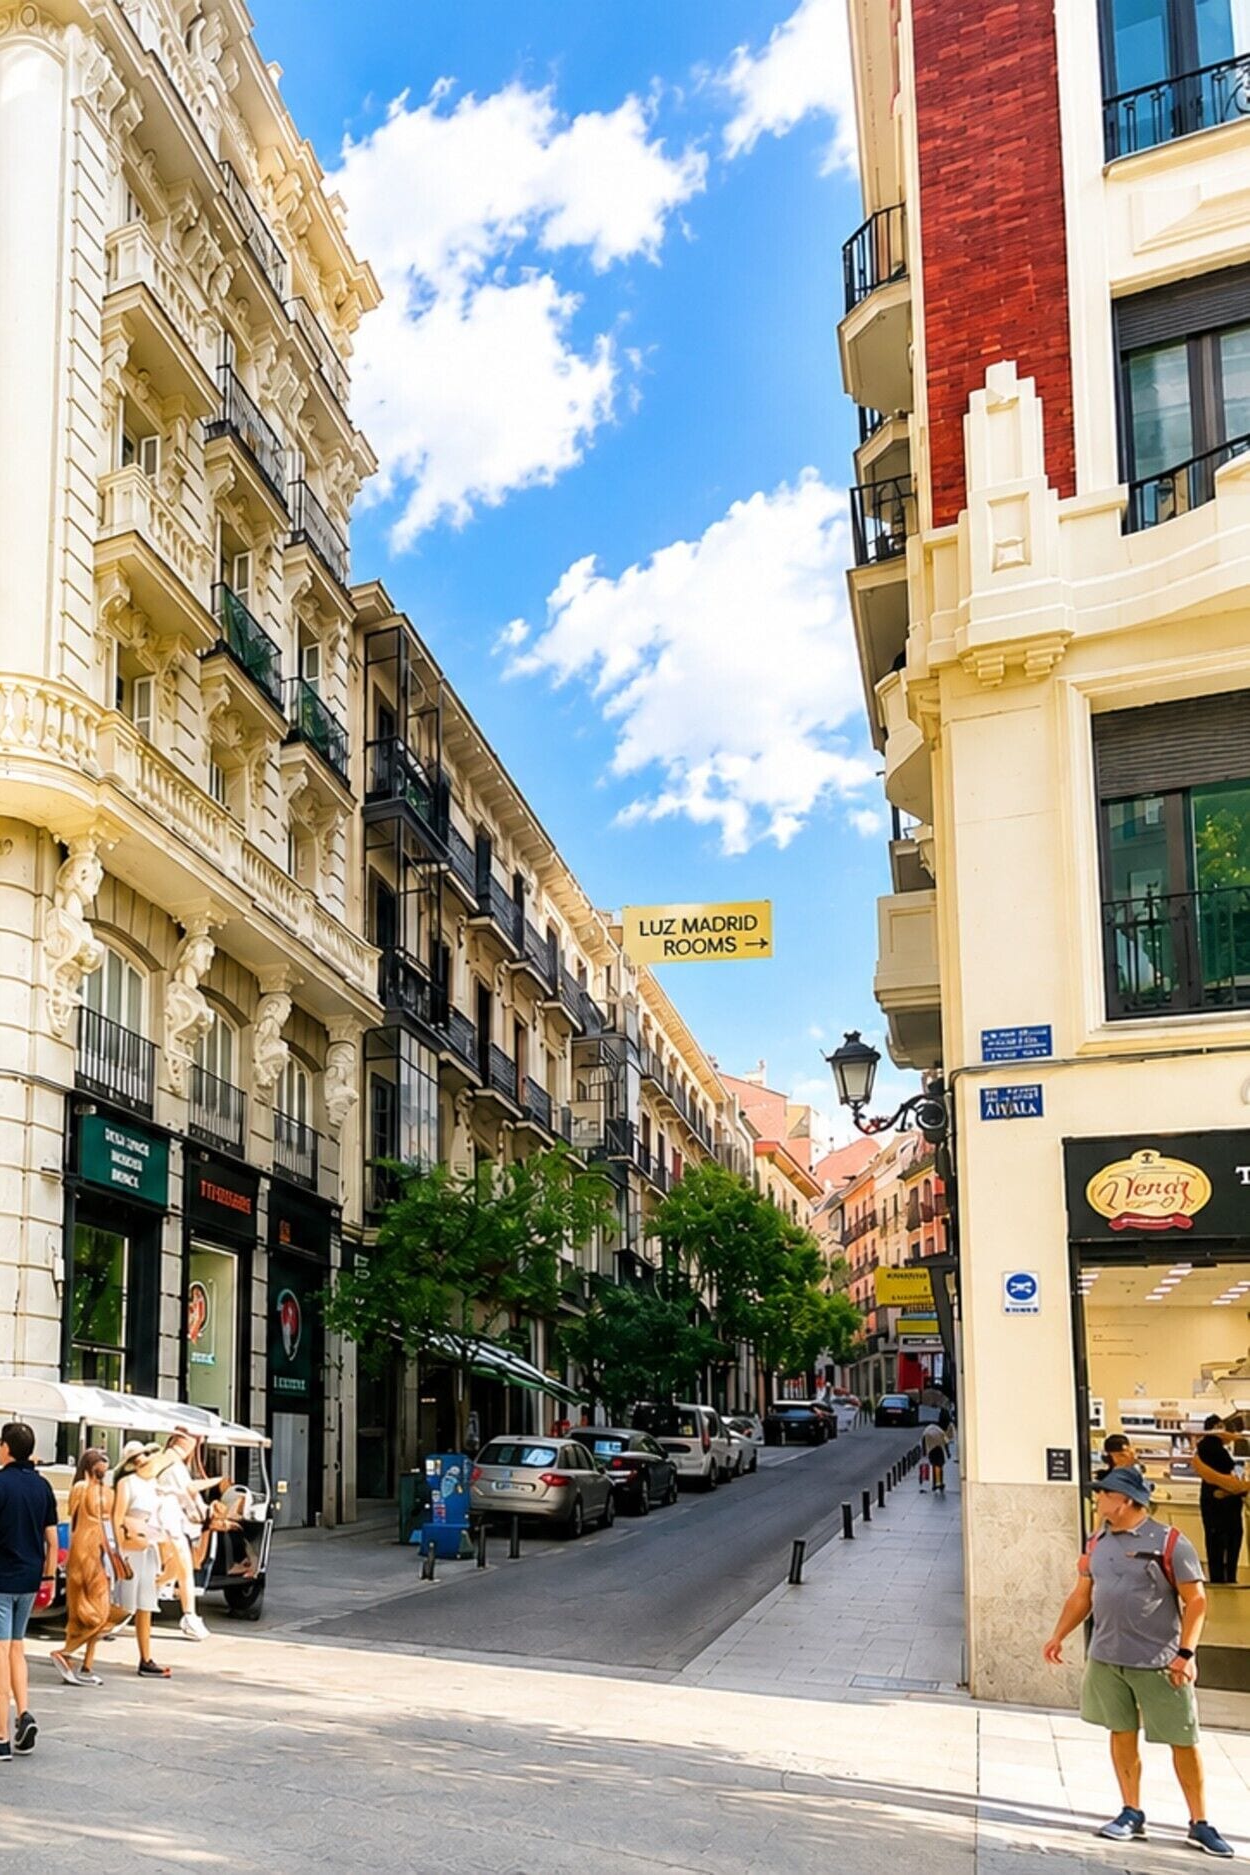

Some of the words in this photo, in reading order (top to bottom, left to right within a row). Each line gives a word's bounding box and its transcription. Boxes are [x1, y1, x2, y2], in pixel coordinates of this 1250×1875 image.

[639, 918, 676, 937] LUZ
[681, 914, 758, 934] MADRID
[663, 936, 737, 956] ROOMS
